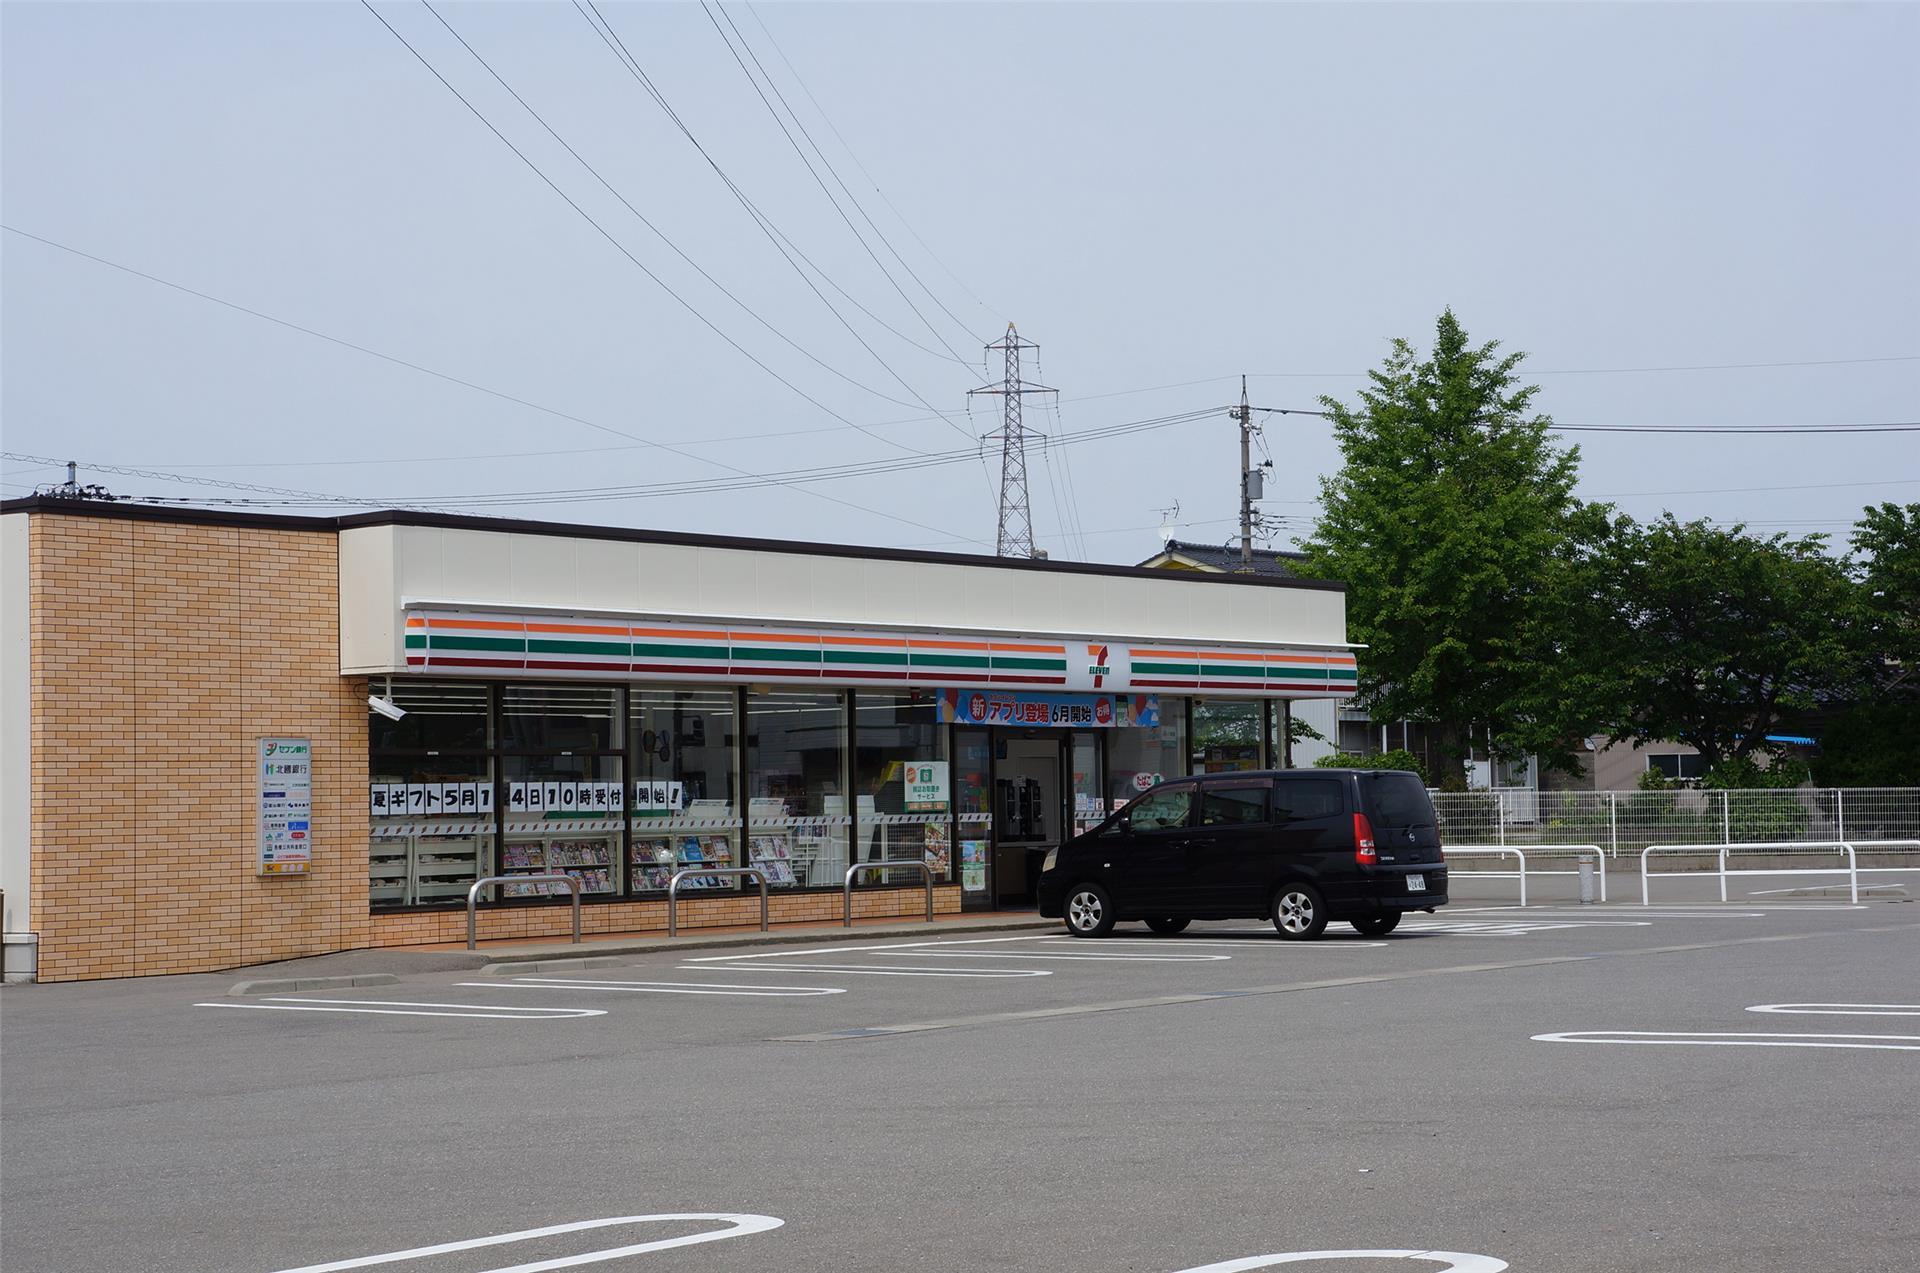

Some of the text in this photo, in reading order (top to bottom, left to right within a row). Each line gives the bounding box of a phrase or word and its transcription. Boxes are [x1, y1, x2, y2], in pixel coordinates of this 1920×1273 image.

[988, 701, 1050, 723] アプリ登場
[1051, 705, 1092, 723] 6月開始
[278, 745, 308, 754] セブン銀行
